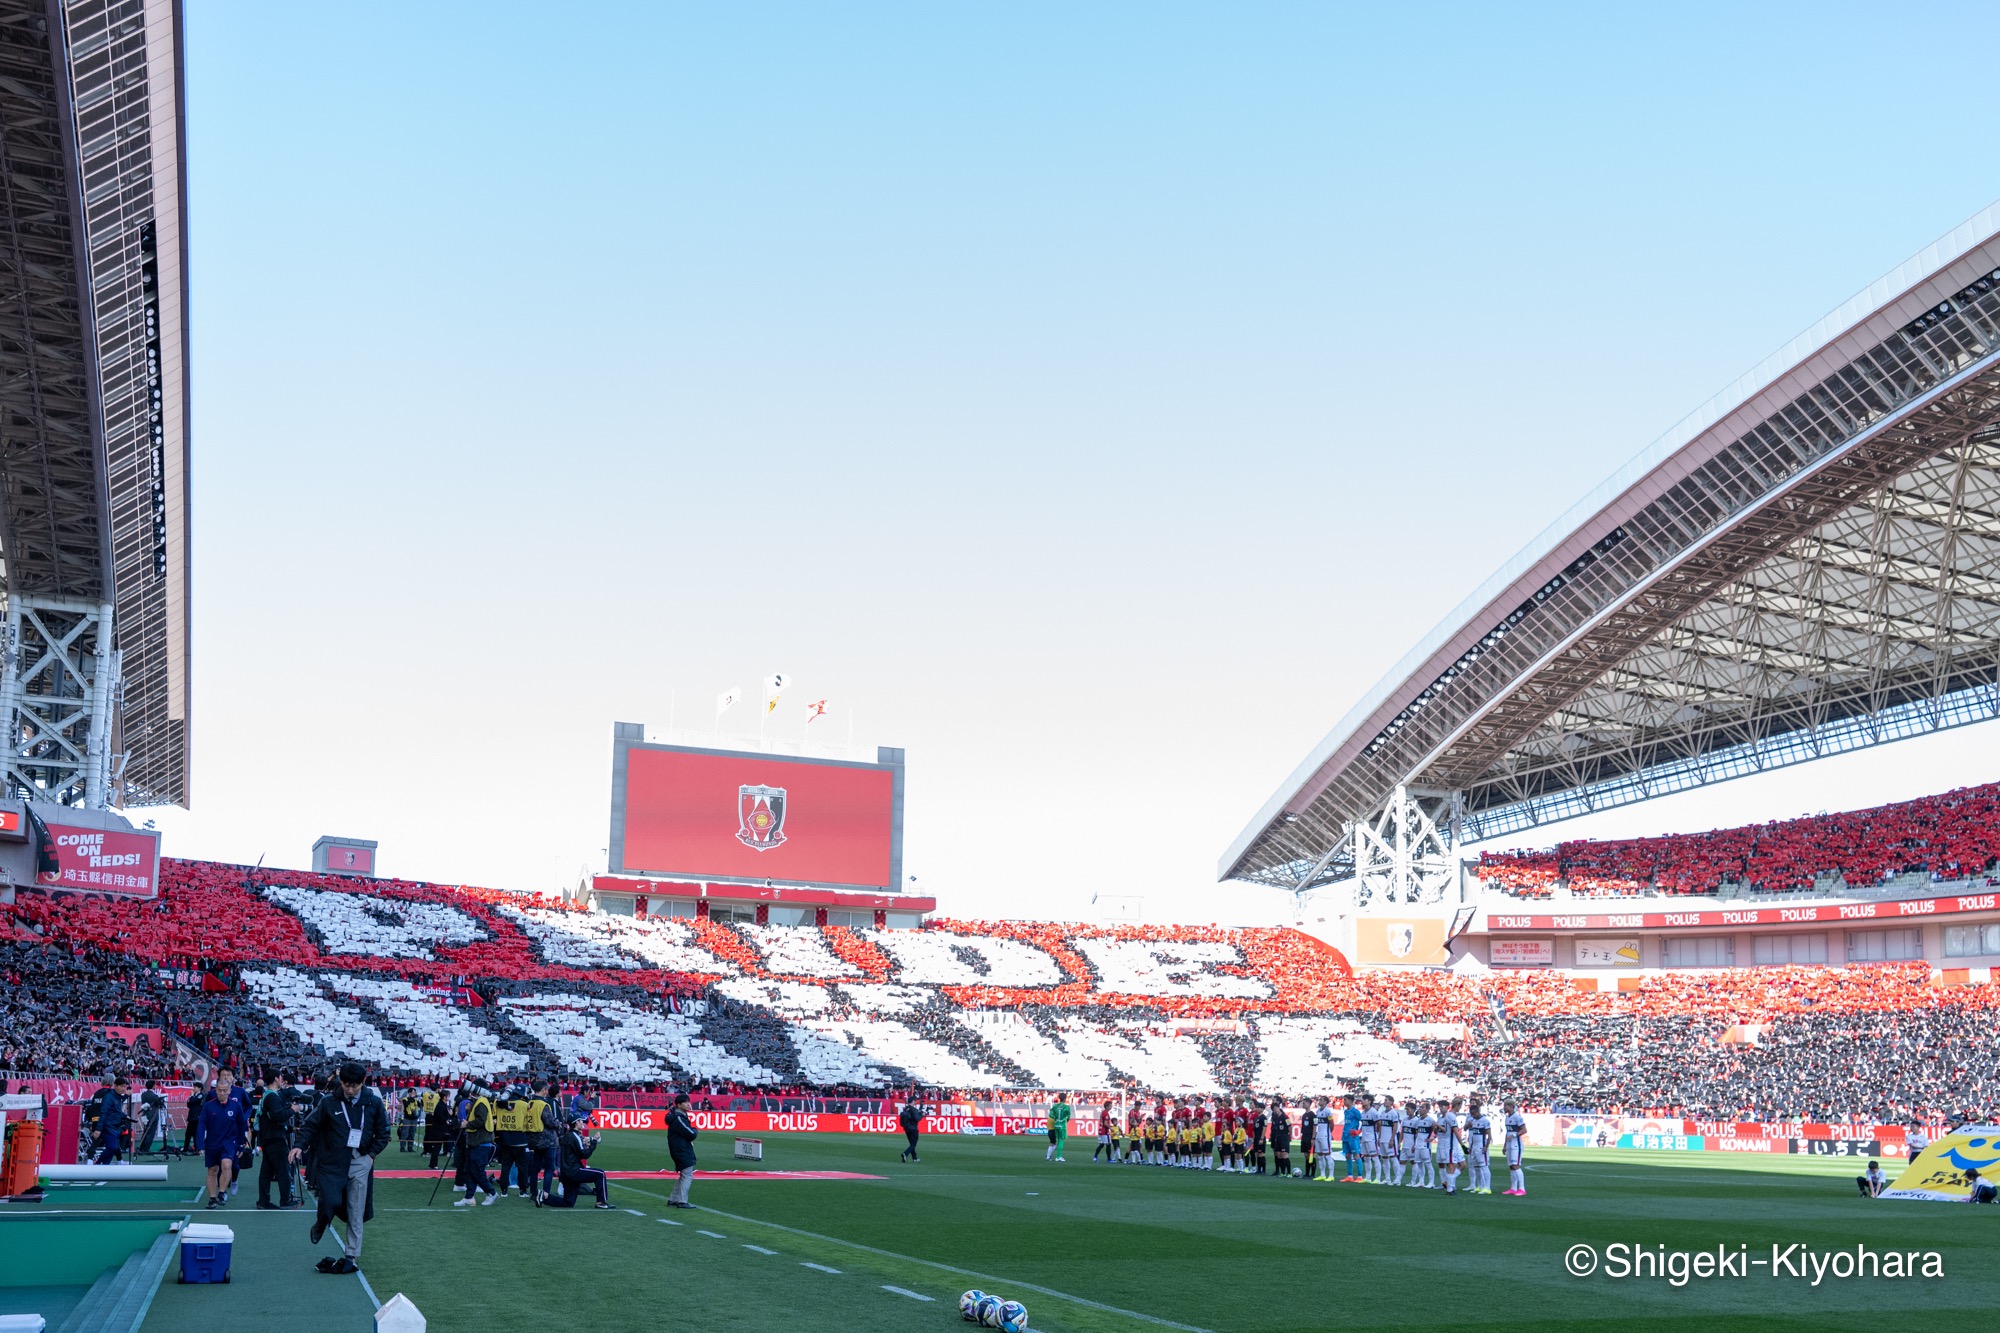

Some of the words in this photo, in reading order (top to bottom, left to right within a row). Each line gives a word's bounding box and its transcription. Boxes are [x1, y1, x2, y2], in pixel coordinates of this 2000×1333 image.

[57, 834, 104, 846] COME
[76, 845, 101, 857] ON
[90, 854, 141, 868] REDS!
[64, 868, 149, 889] 埼玉縣信用金庫
[1899, 900, 1935, 915] POLUS
[1958, 895, 1995, 910] POLUS
[1722, 911, 1758, 923] POLUS
[1780, 909, 1817, 921] POLUS
[1839, 905, 1876, 918] POLUS
[1498, 916, 1531, 928] POLUS
[1552, 916, 1586, 928] POLUS
[1608, 915, 1643, 927] POLUS
[1664, 914, 1700, 926] POLUS
[1581, 948, 1612, 962] テレ玉
[418, 986, 451, 997] Fighting
[501, 1115, 516, 1123] 005
[600, 1112, 651, 1129] POLUS
[687, 1113, 736, 1129] POLUS
[767, 1114, 818, 1131] POLUS
[848, 1116, 897, 1132] POLUS
[1695, 1122, 1737, 1137] POLUS
[1761, 1123, 1803, 1139] POLUS
[1829, 1125, 1875, 1141] POLUS
[1632, 1136, 1688, 1150] 明治安田
[1719, 1138, 1771, 1152] KONAMI
[1814, 1140, 1871, 1157] いちご
